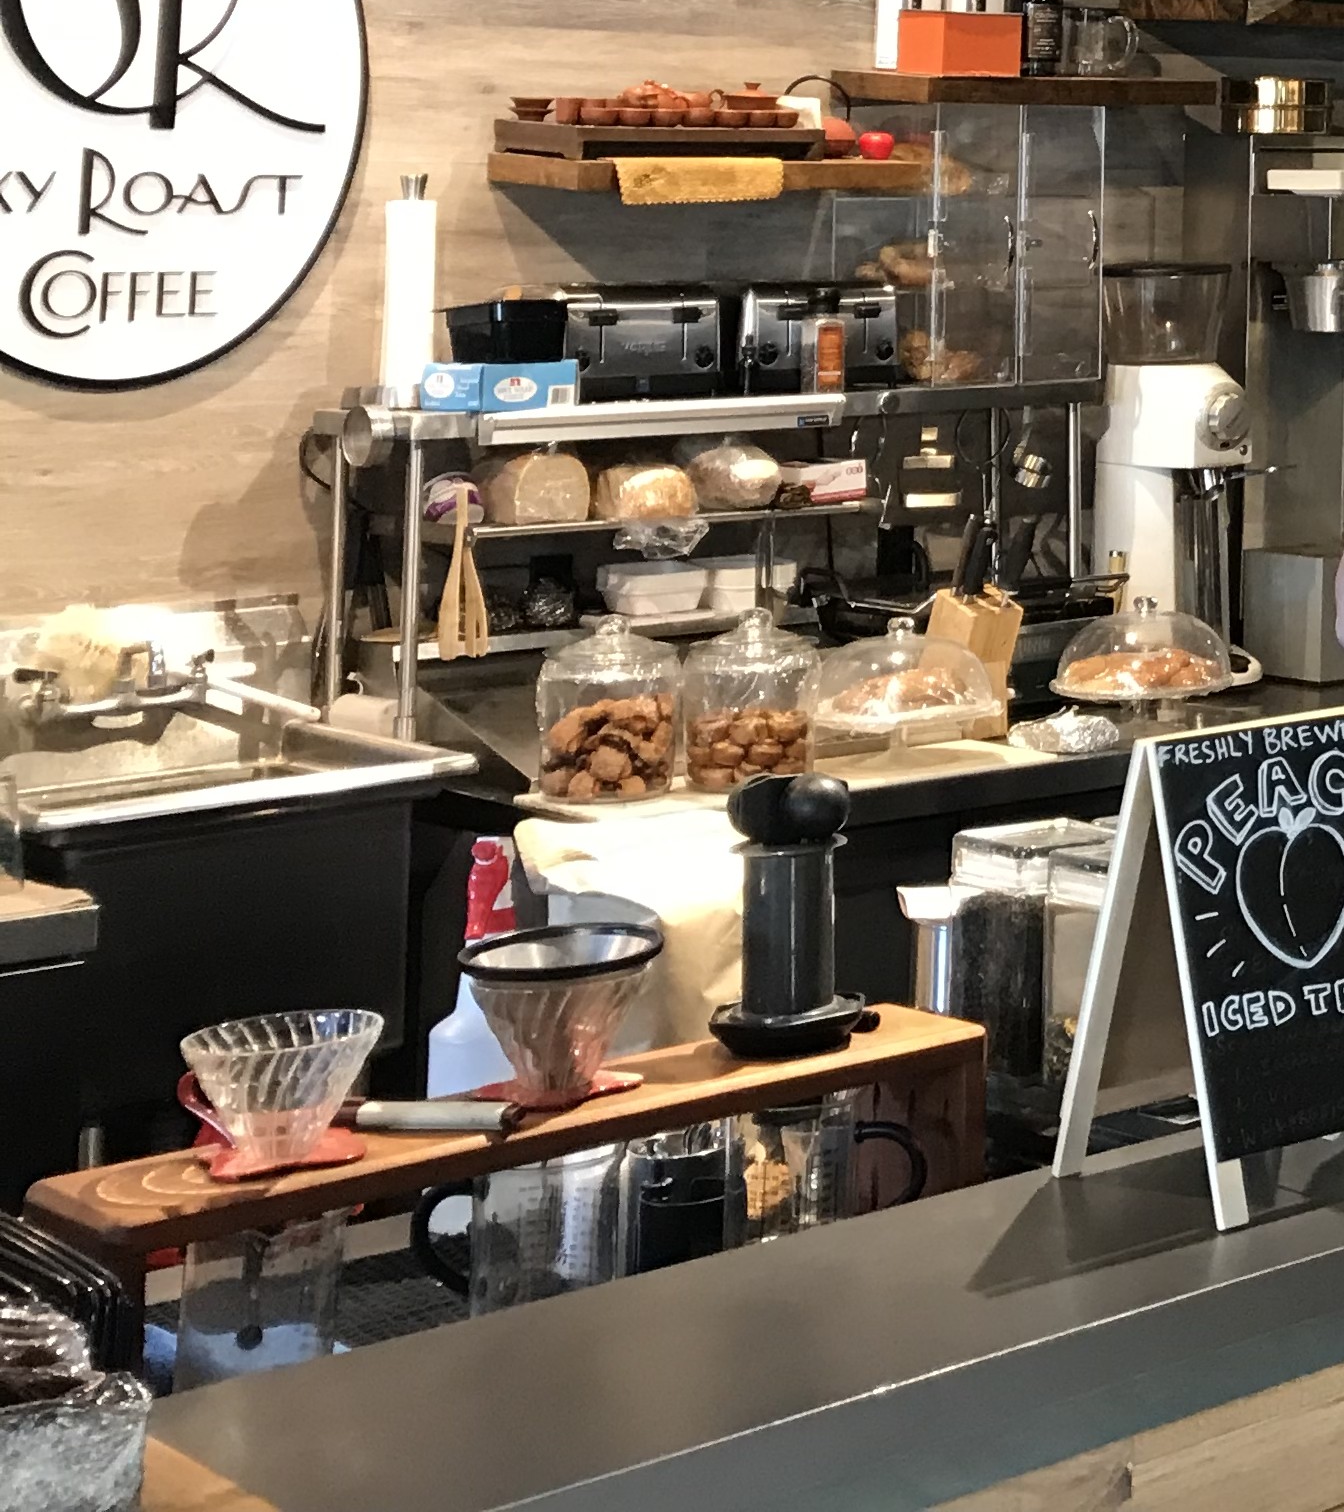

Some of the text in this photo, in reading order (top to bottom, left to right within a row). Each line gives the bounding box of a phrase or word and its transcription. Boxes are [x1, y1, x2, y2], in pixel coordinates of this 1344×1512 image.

[78, 148, 303, 236] ROAST
[18, 250, 217, 339] COFFEE
[1158, 730, 1253, 768] FRESHLY
[1201, 991, 1296, 1037] ICED
